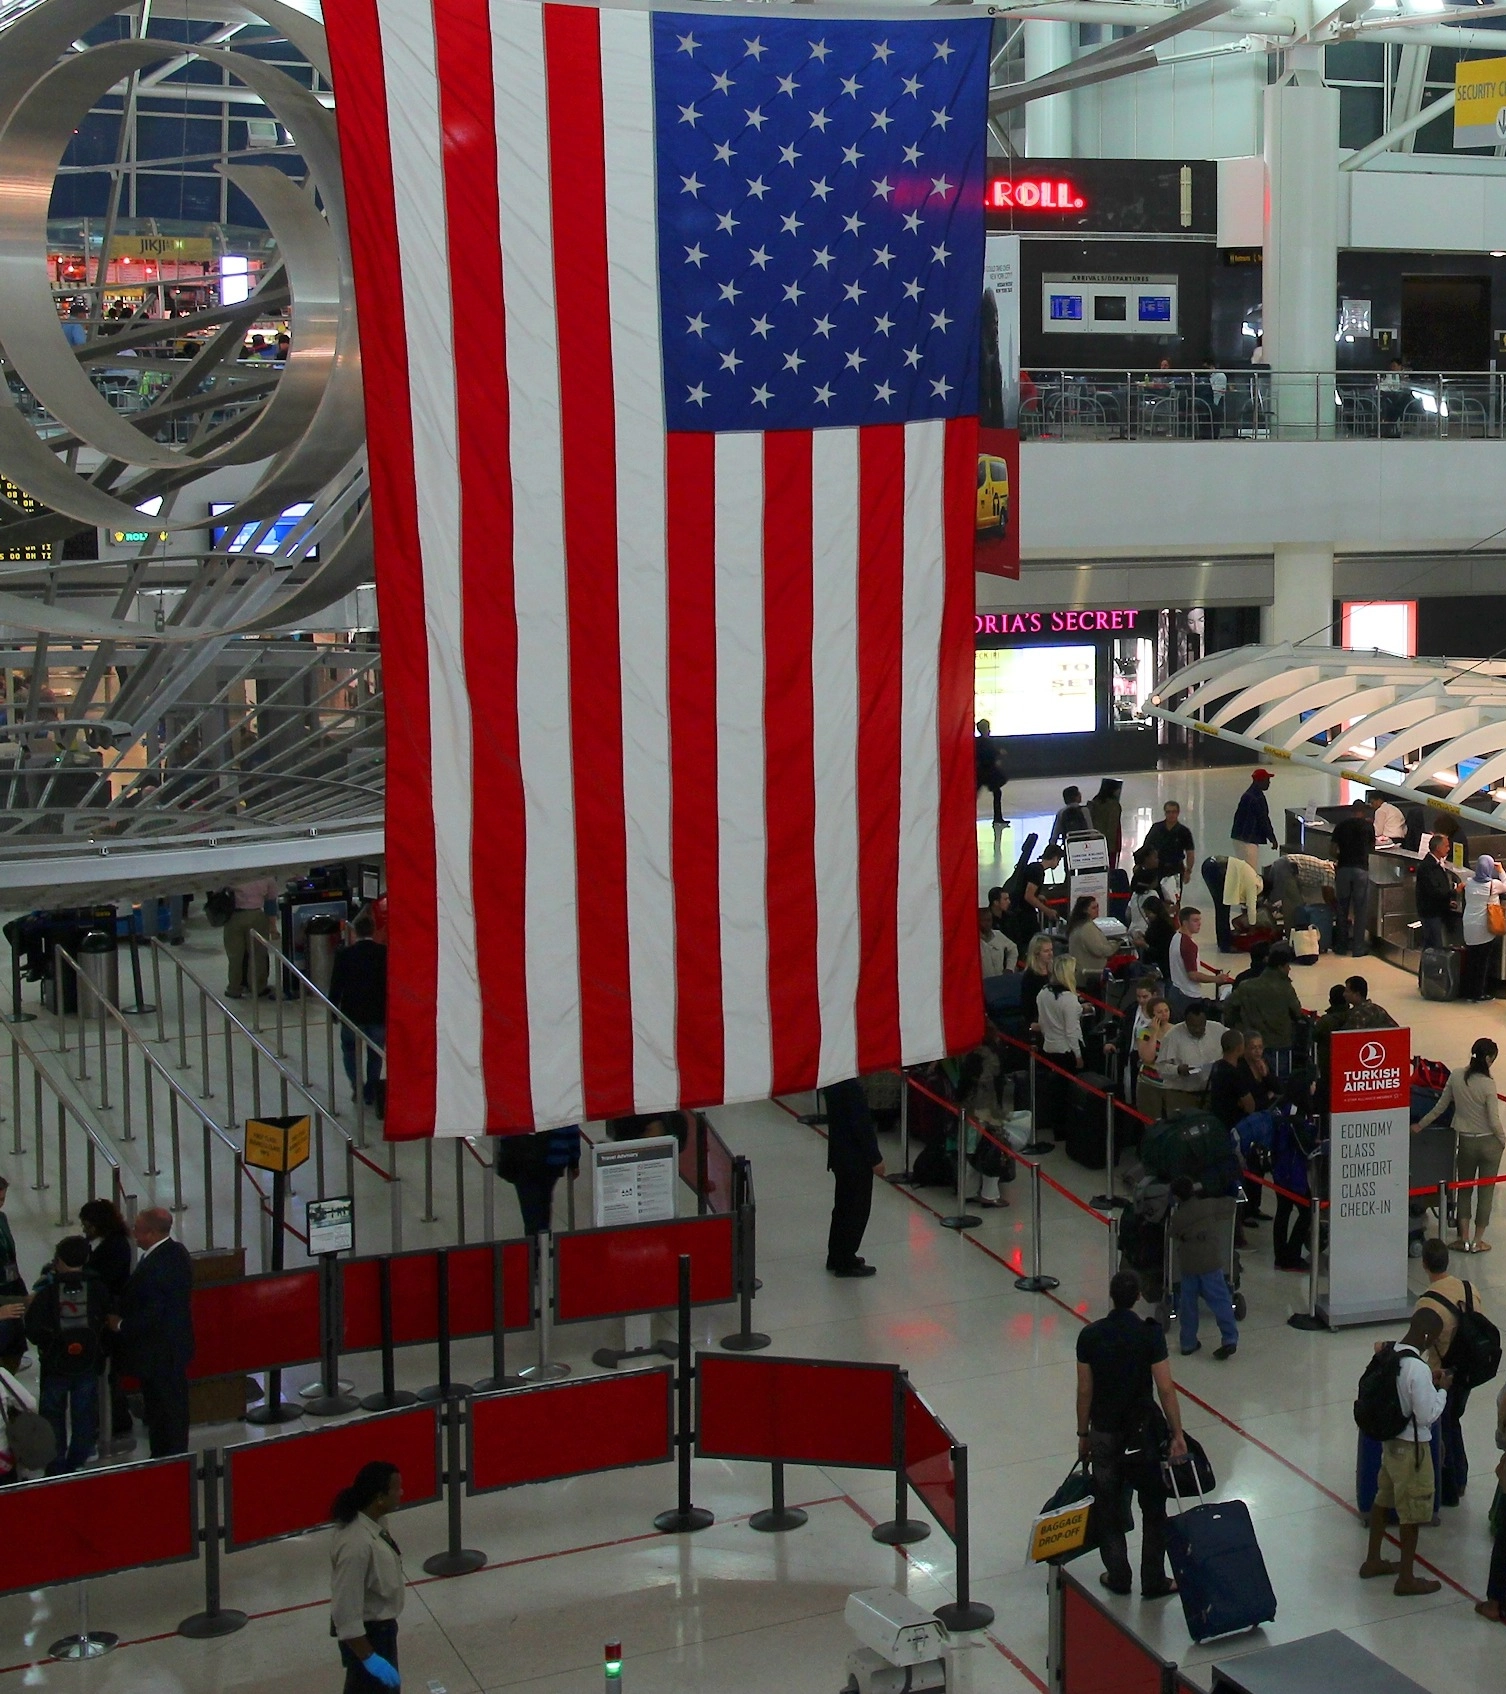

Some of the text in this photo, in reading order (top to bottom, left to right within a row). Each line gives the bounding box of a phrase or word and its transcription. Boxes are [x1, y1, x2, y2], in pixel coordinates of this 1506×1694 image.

[1457, 82, 1497, 100] SECURITY
[1051, 610, 1139, 632] SECRET
[1344, 1067, 1400, 1081] TURKISH
[1343, 1078, 1401, 1092] AIRLINES
[1341, 1121, 1393, 1139] ECONOMY
[1341, 1142, 1376, 1159] CLASS
[1342, 1160, 1393, 1179] COMFORT
[1342, 1181, 1376, 1199] CLASS
[1340, 1199, 1391, 1217] CHECK-IN
[1040, 1513, 1083, 1535] BAGGAGE
[1038, 1526, 1081, 1547] DROP-OFF
